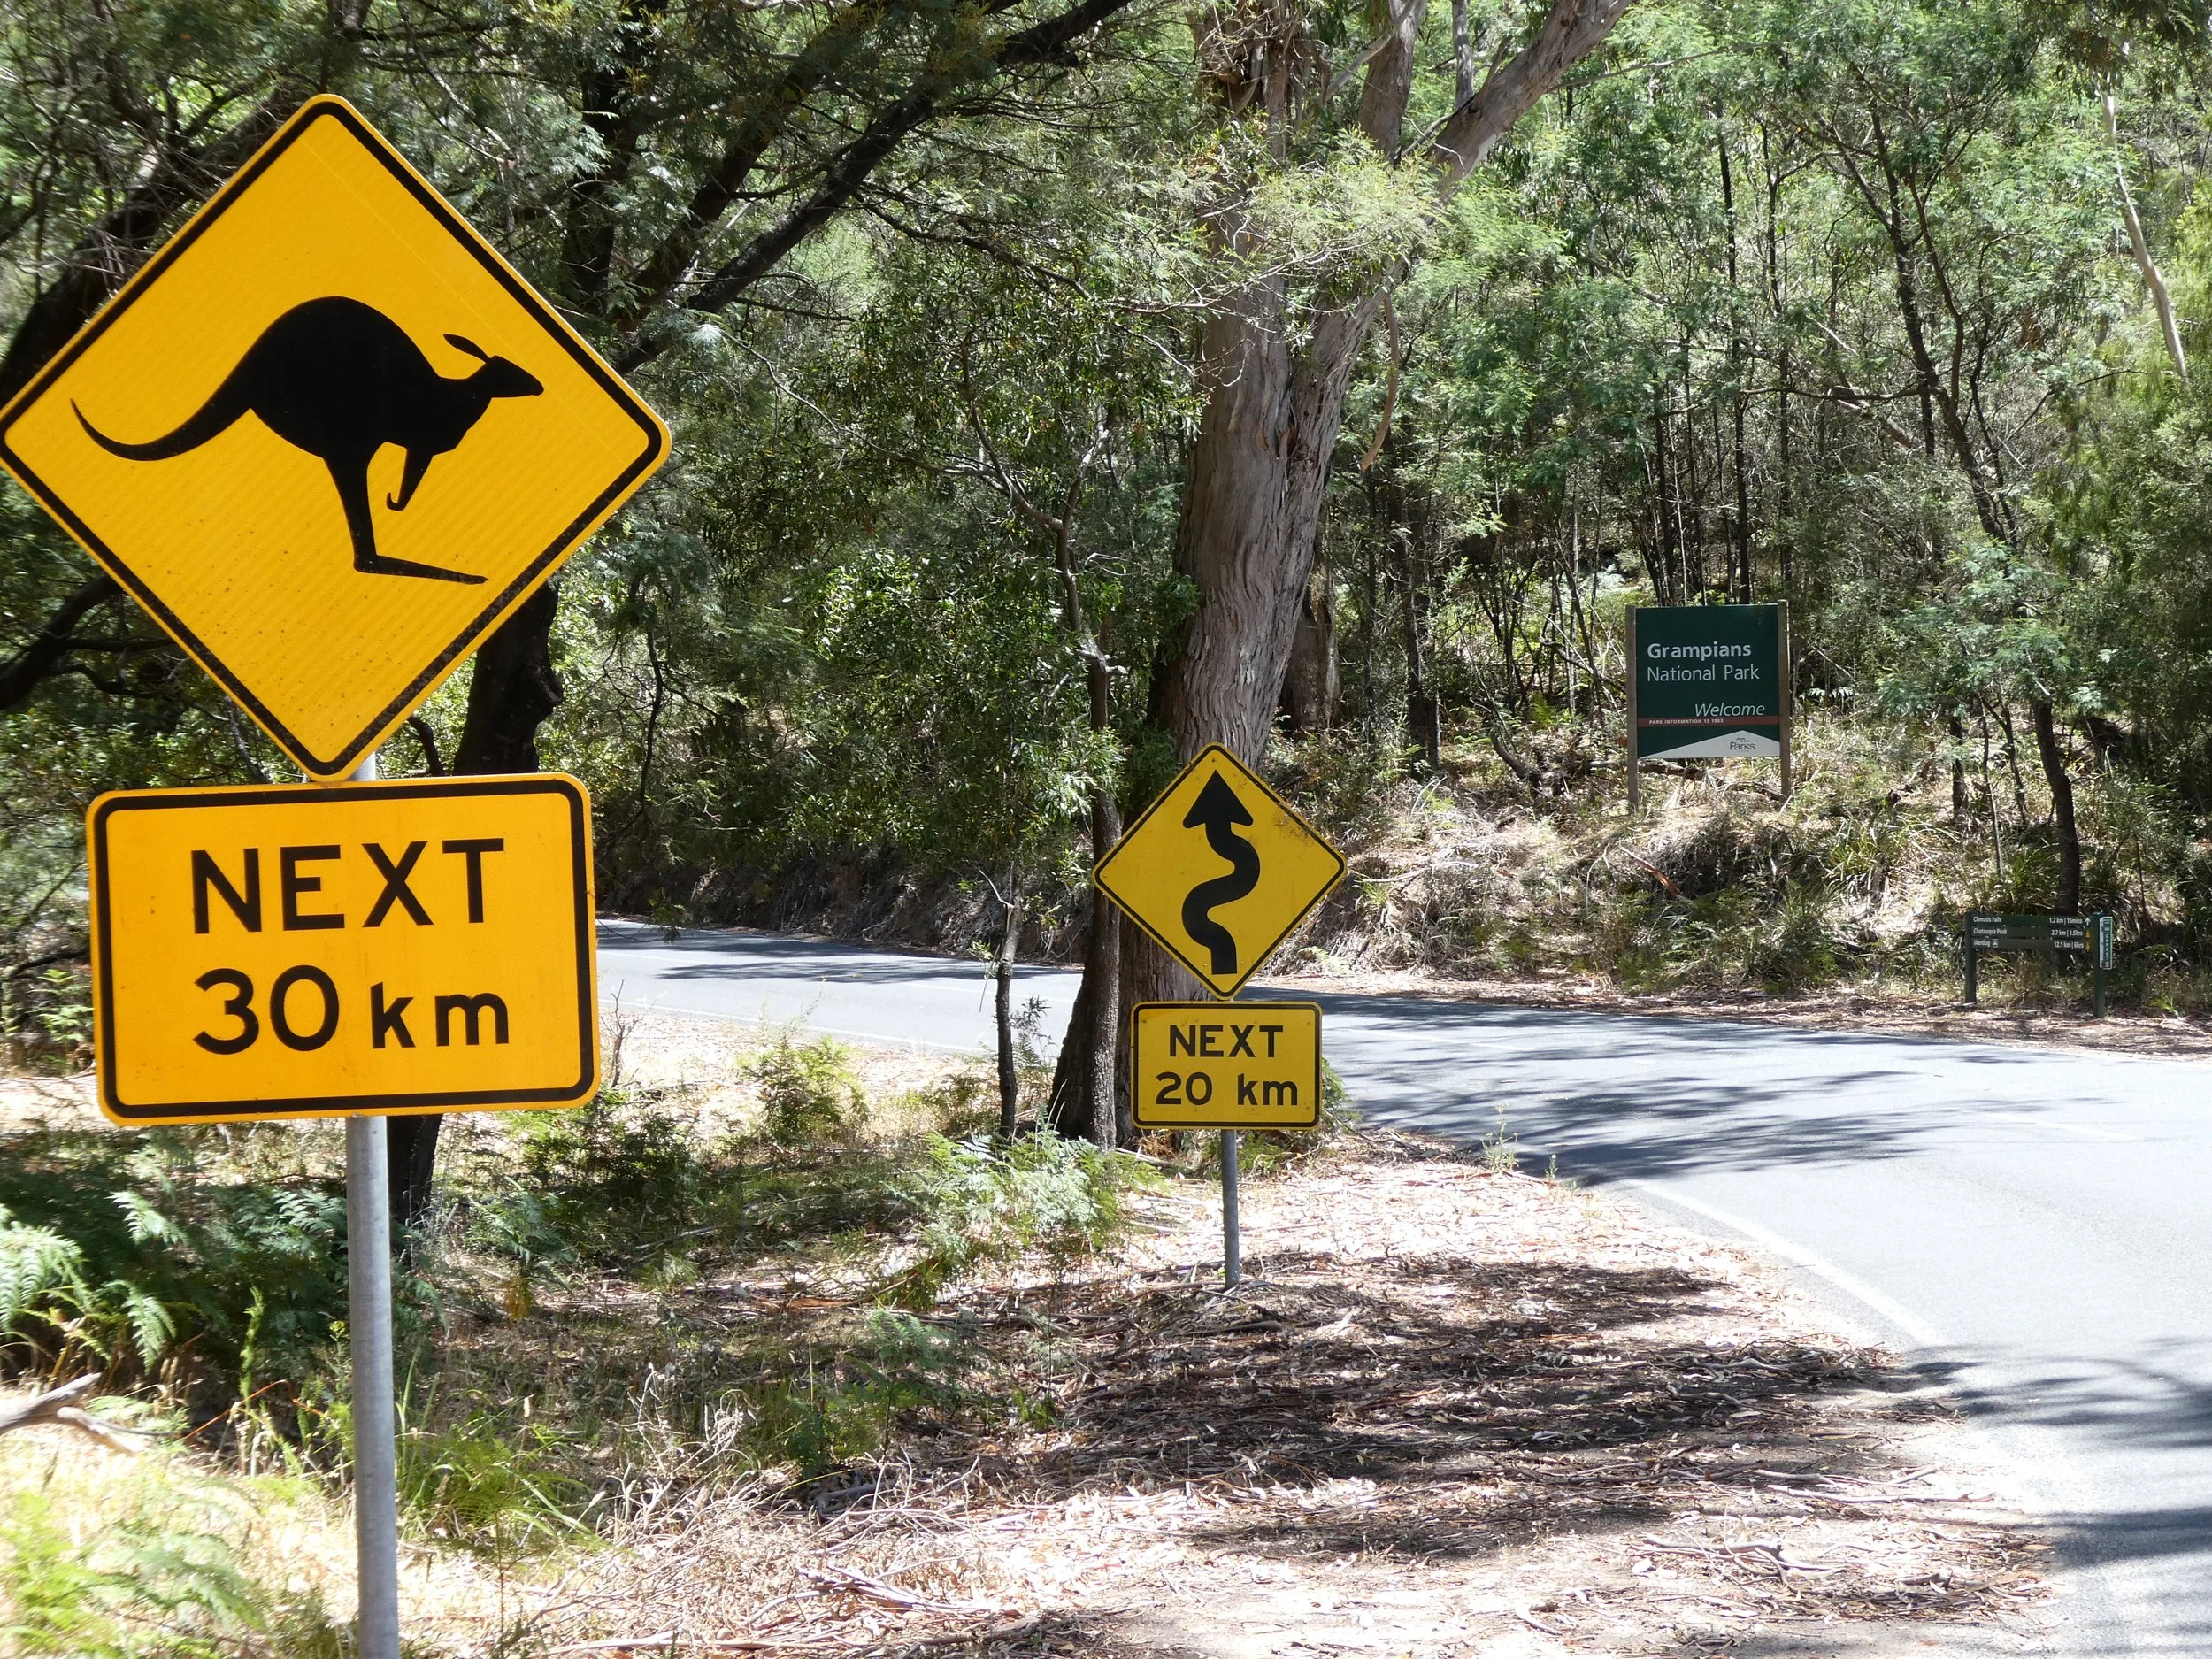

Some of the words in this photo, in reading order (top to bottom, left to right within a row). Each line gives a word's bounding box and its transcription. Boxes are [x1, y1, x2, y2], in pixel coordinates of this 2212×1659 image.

[1647, 641, 1752, 661] Grampians
[1647, 664, 1716, 681] National
[1724, 664, 1760, 680] Park
[1694, 703, 1765, 717] Welcome
[1730, 741, 1755, 750] Parks
[191, 837, 504, 934] NEXT
[193, 964, 340, 1056] 30
[370, 982, 510, 1049] km
[1169, 1025, 1284, 1058] NEXT
[1155, 1071, 1213, 1106] 20
[1237, 1072, 1298, 1106] km
